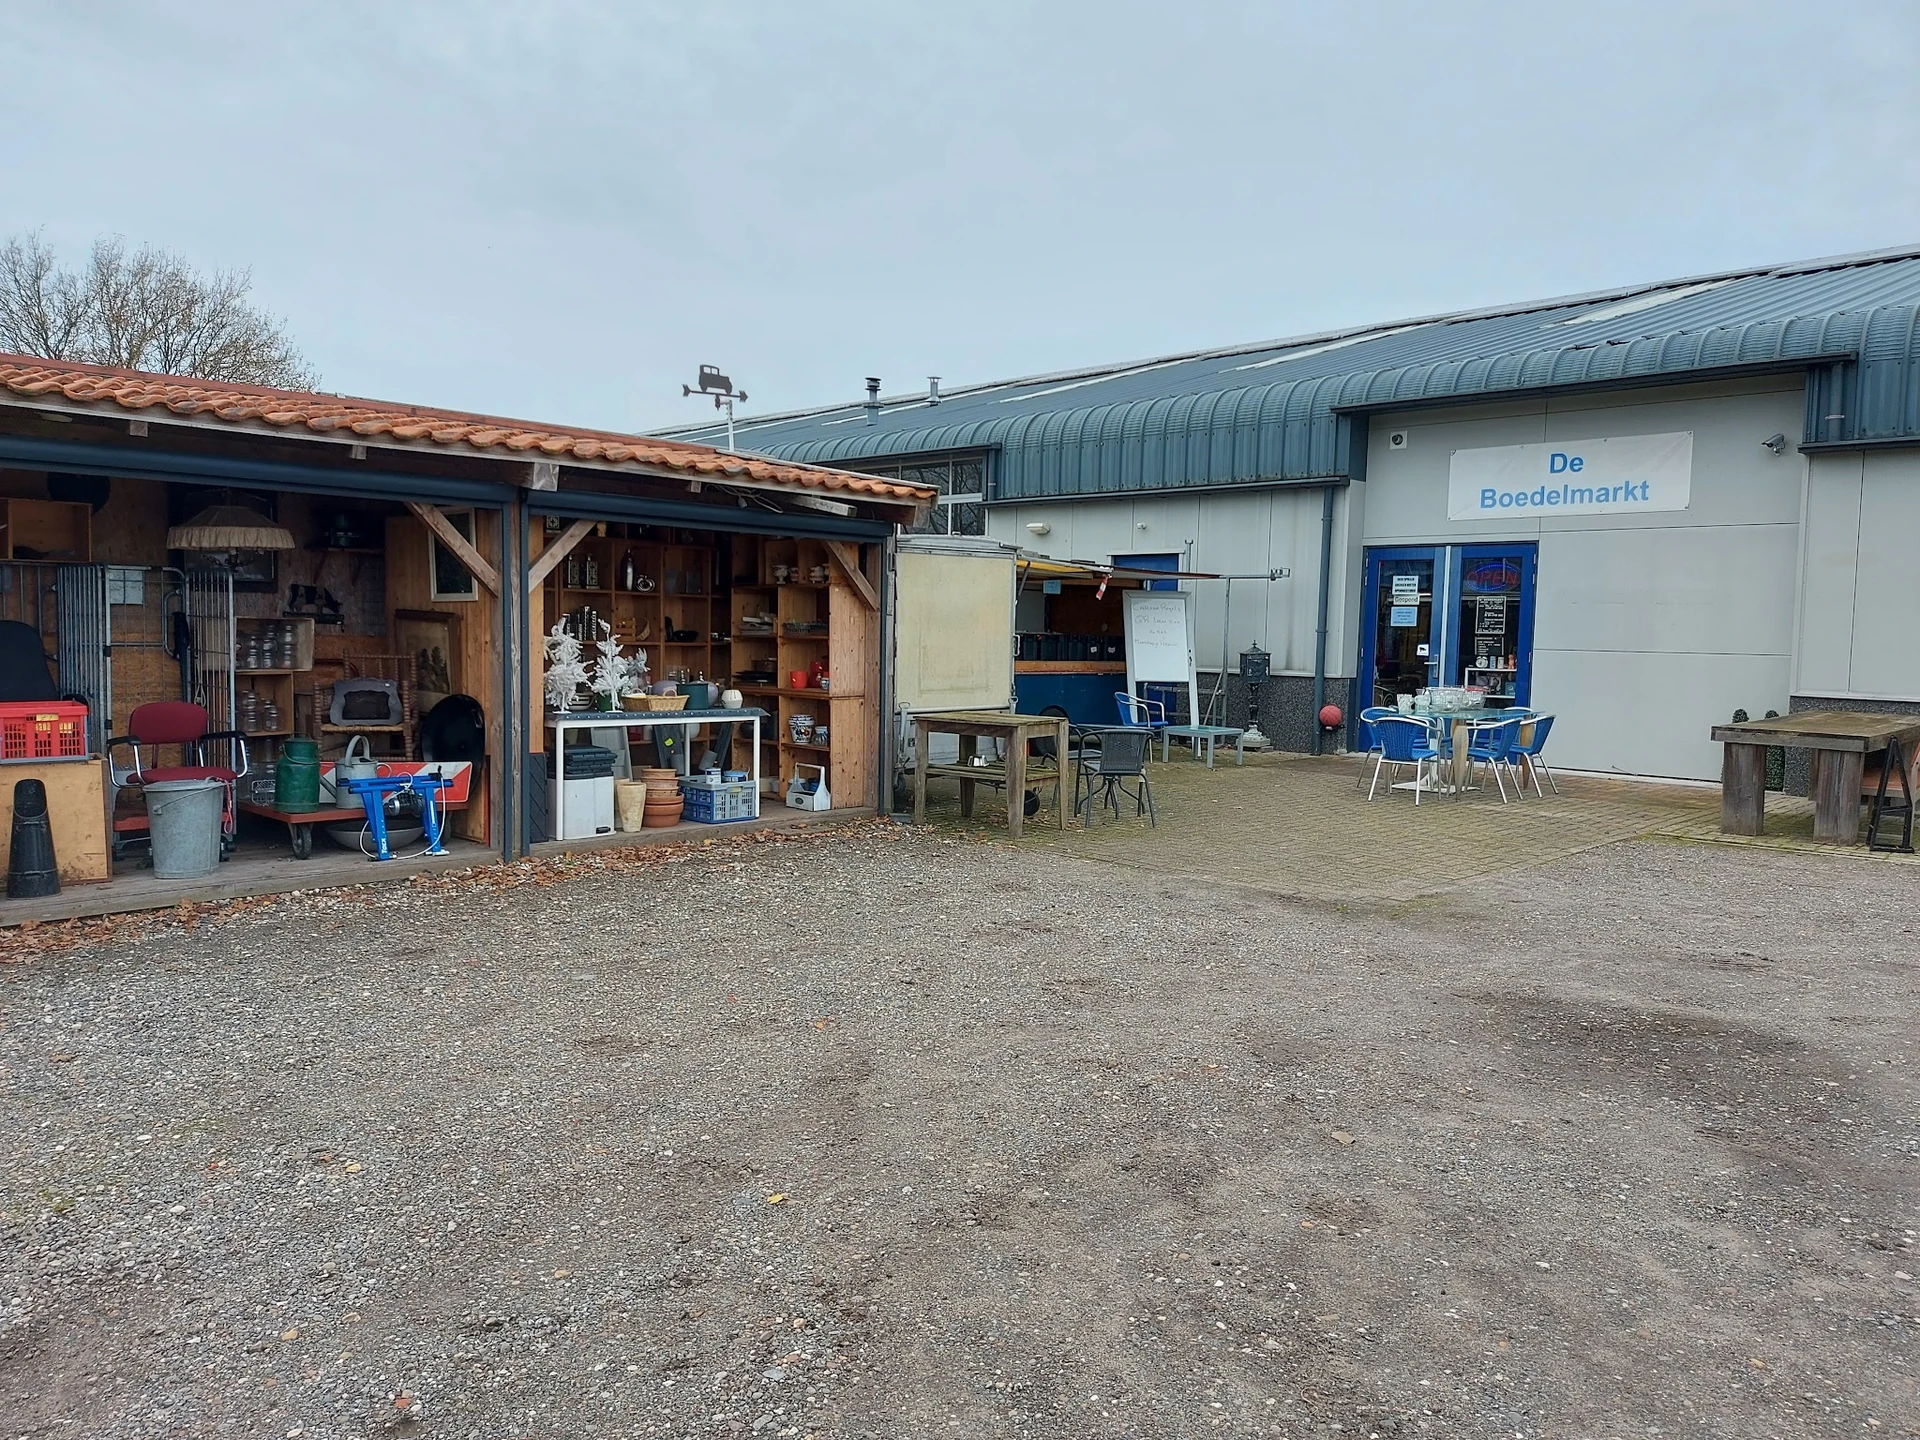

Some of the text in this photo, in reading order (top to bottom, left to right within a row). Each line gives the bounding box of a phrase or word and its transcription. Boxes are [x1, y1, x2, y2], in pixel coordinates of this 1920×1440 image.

[1549, 453, 1584, 474] De
[1480, 479, 1650, 509] Boedelmarkt
[1467, 569, 1518, 586] OPEN
